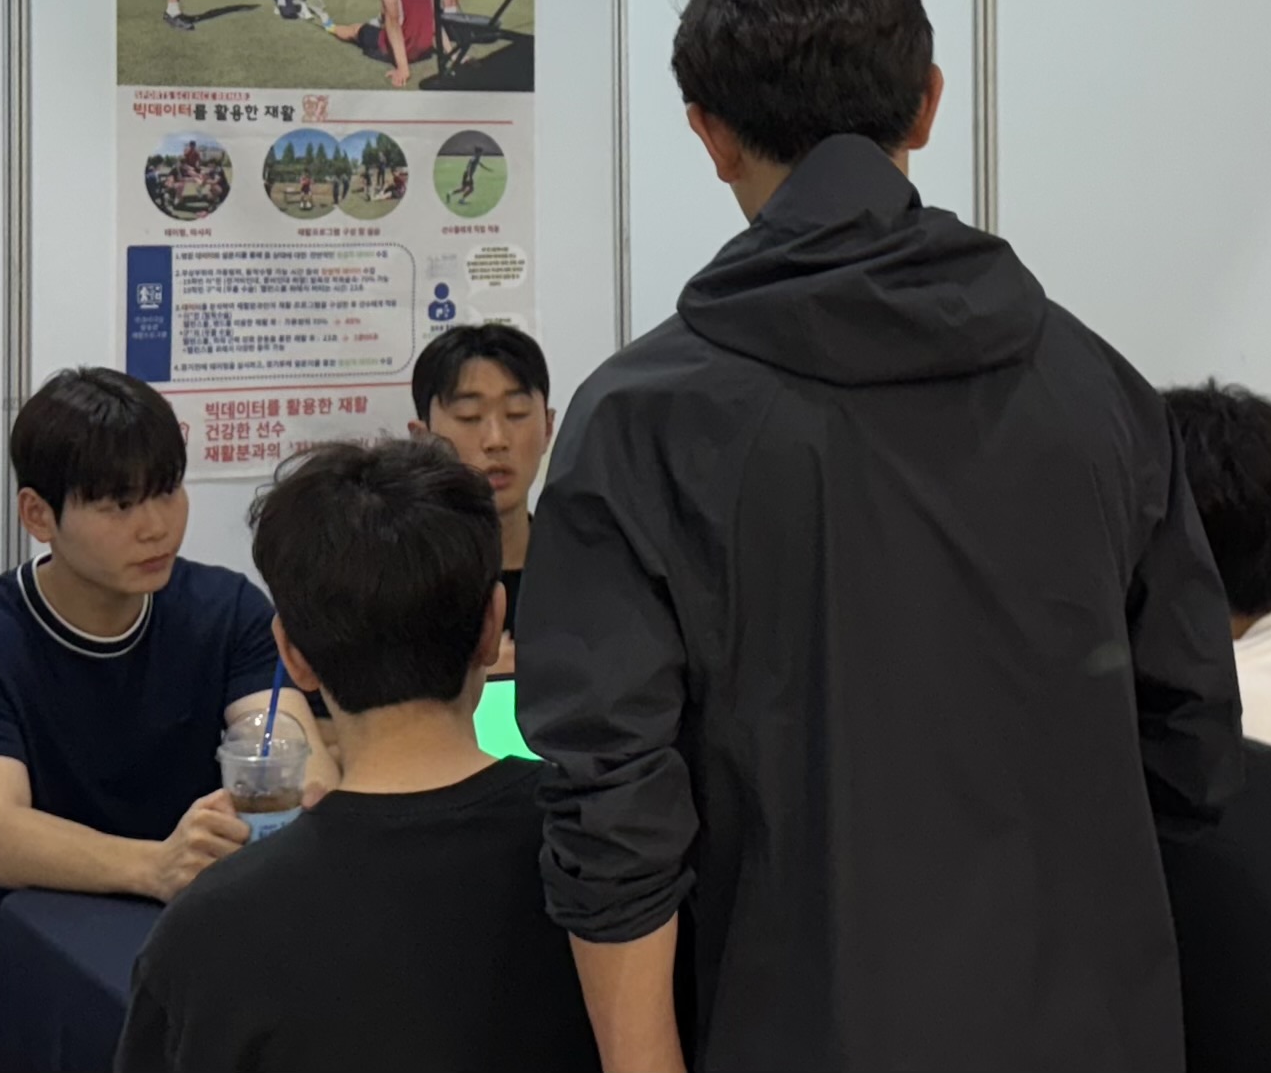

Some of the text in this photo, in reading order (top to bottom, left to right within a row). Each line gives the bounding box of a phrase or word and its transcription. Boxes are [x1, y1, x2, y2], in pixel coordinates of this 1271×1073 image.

[133, 102, 296, 122] 빅데이터를 활용한 재활
[205, 395, 368, 419] 빅데이터를 활용한 재활
[205, 421, 286, 442] 건강한 선수
[204, 442, 281, 462] 재활분과의
